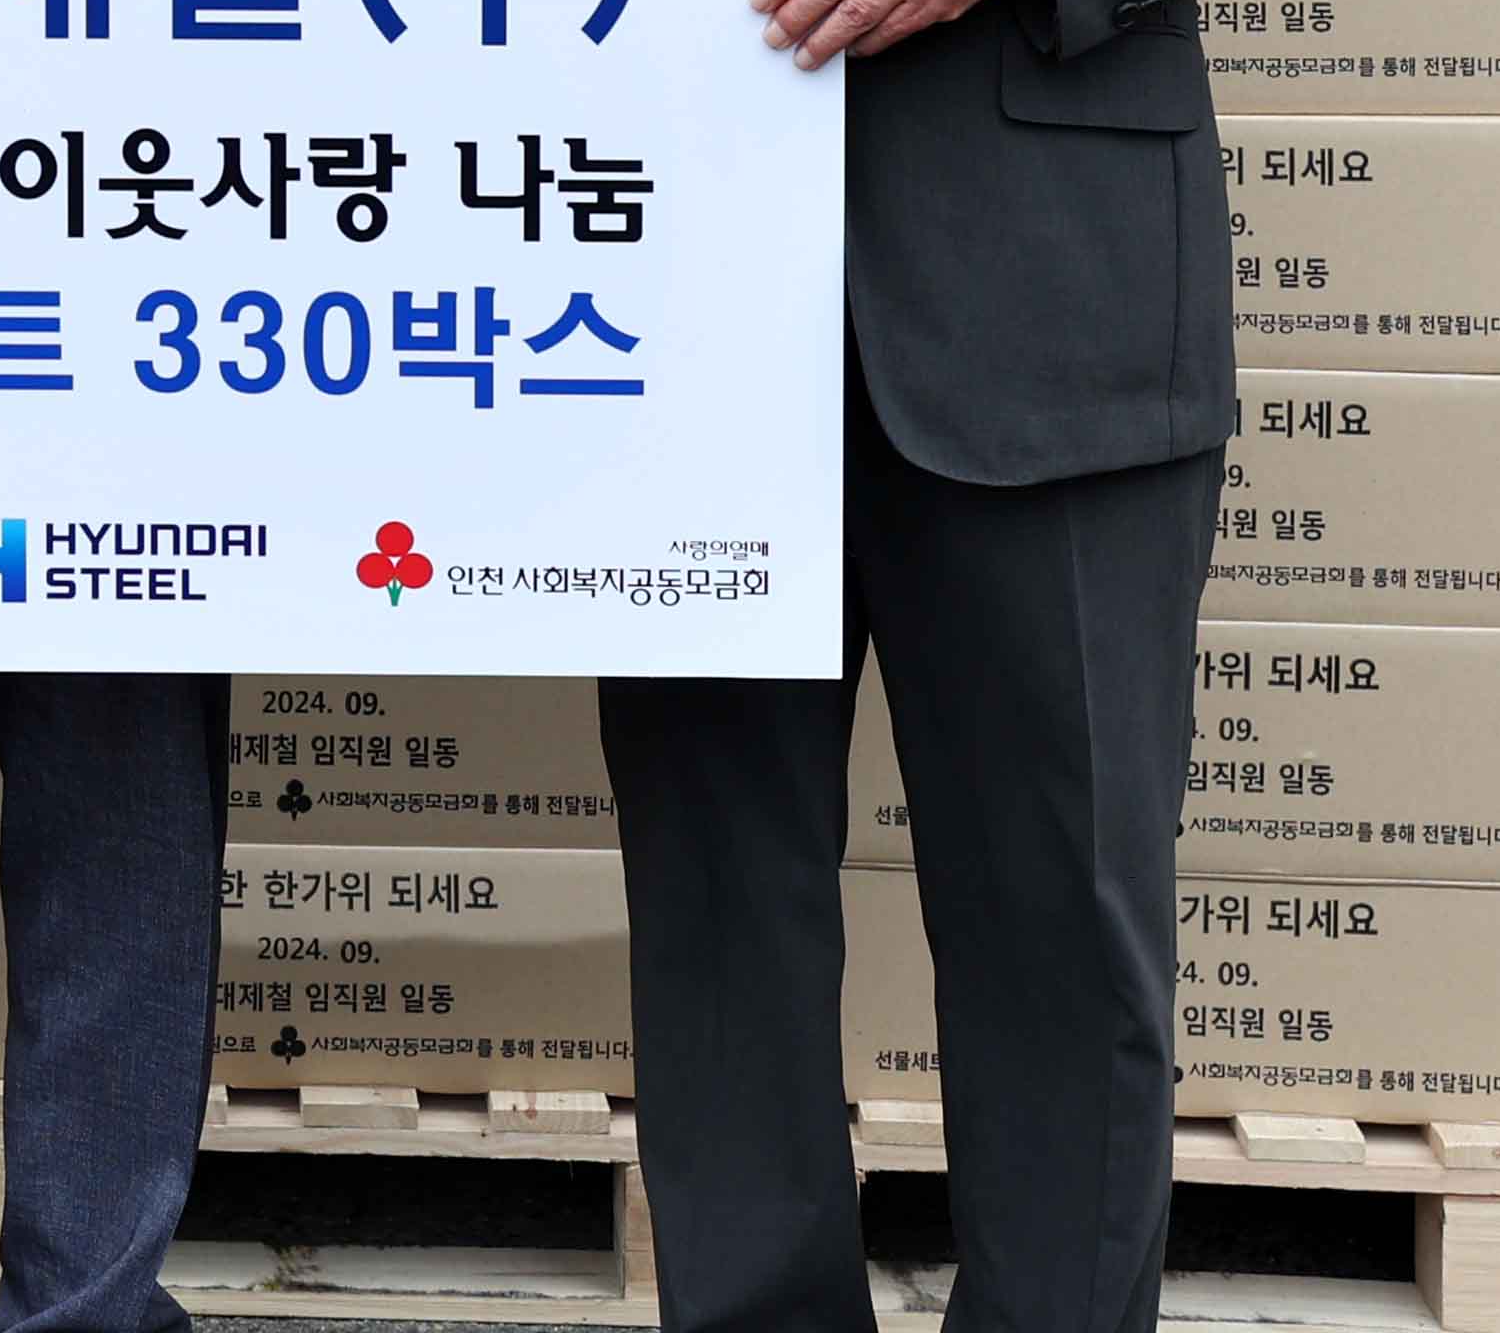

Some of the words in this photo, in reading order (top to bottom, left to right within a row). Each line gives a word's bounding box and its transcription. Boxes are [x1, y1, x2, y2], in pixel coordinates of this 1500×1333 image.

[0, 128, 407, 243] 이웃사랑
[453, 134, 654, 244] 나눔
[134, 286, 646, 410] 330박스
[46, 523, 267, 557] HYUNDAI
[669, 540, 769, 561] 사랑의열매
[46, 567, 207, 601] STEEL
[447, 565, 503, 596] 인천
[512, 566, 769, 607] 사회복지공동모금회
